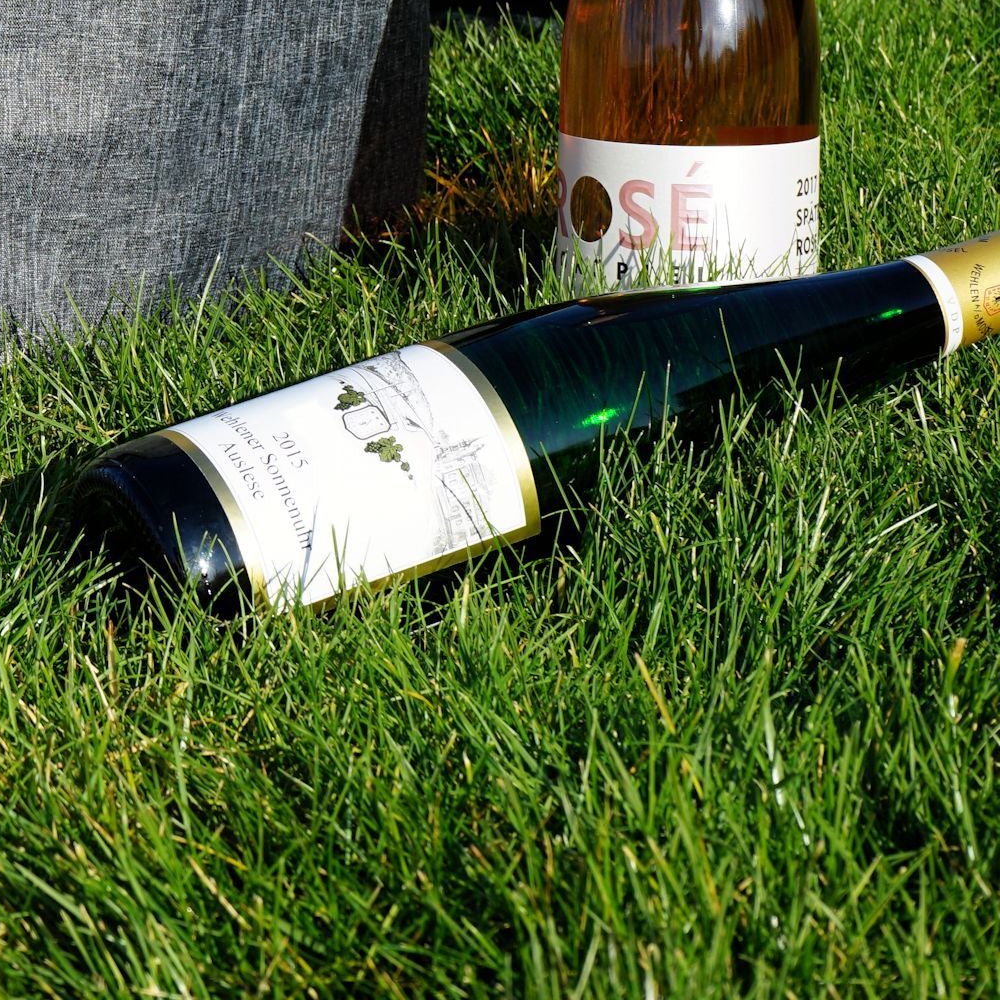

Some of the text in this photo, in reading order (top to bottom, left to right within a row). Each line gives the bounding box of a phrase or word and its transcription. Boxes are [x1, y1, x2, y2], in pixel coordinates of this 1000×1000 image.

[556, 161, 714, 251] ROSÉ
[970, 263, 985, 303] WEHLEN
[217, 443, 265, 500] Auslese
[272, 431, 309, 469] 2015
[212, 410, 313, 551] Wehlener Sonnenuhr
